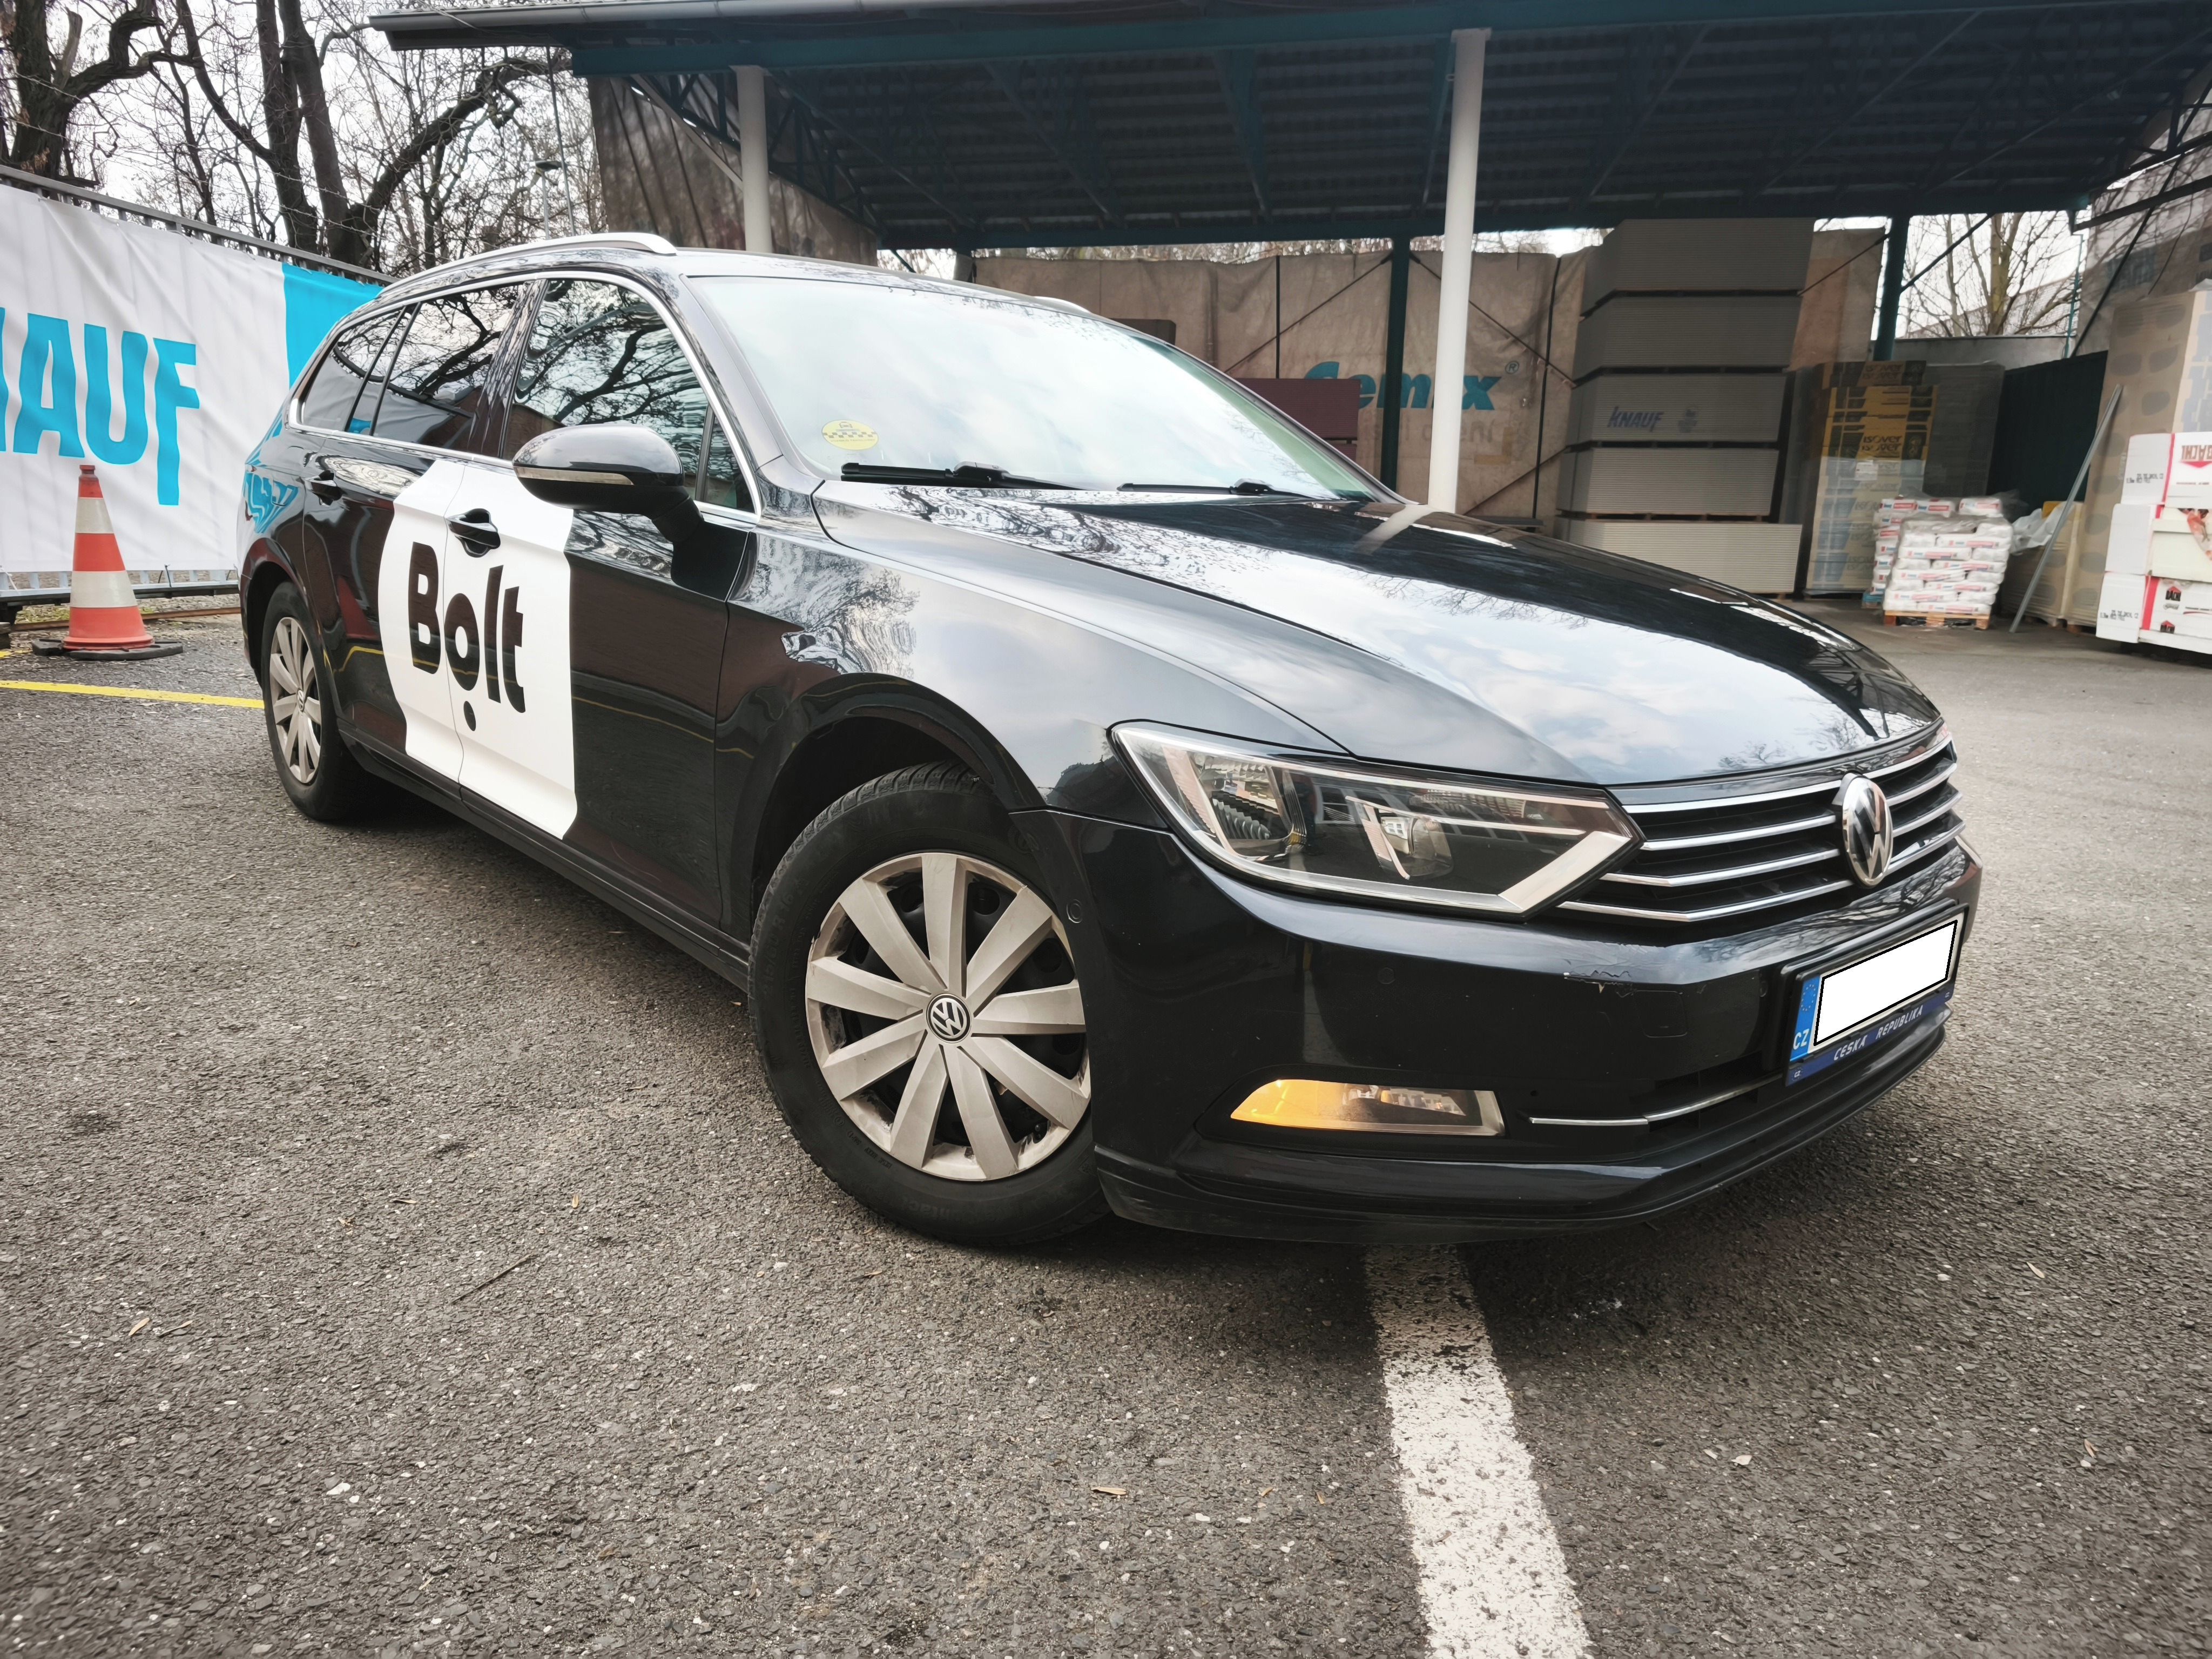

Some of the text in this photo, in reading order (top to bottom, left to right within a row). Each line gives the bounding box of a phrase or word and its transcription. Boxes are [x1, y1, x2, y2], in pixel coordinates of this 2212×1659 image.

[0, 307, 200, 506] AUF
[407, 541, 526, 731] Bolt
[1793, 1029, 1810, 1050] CZ
[1875, 1004, 1923, 1040] REPUBLIKA
